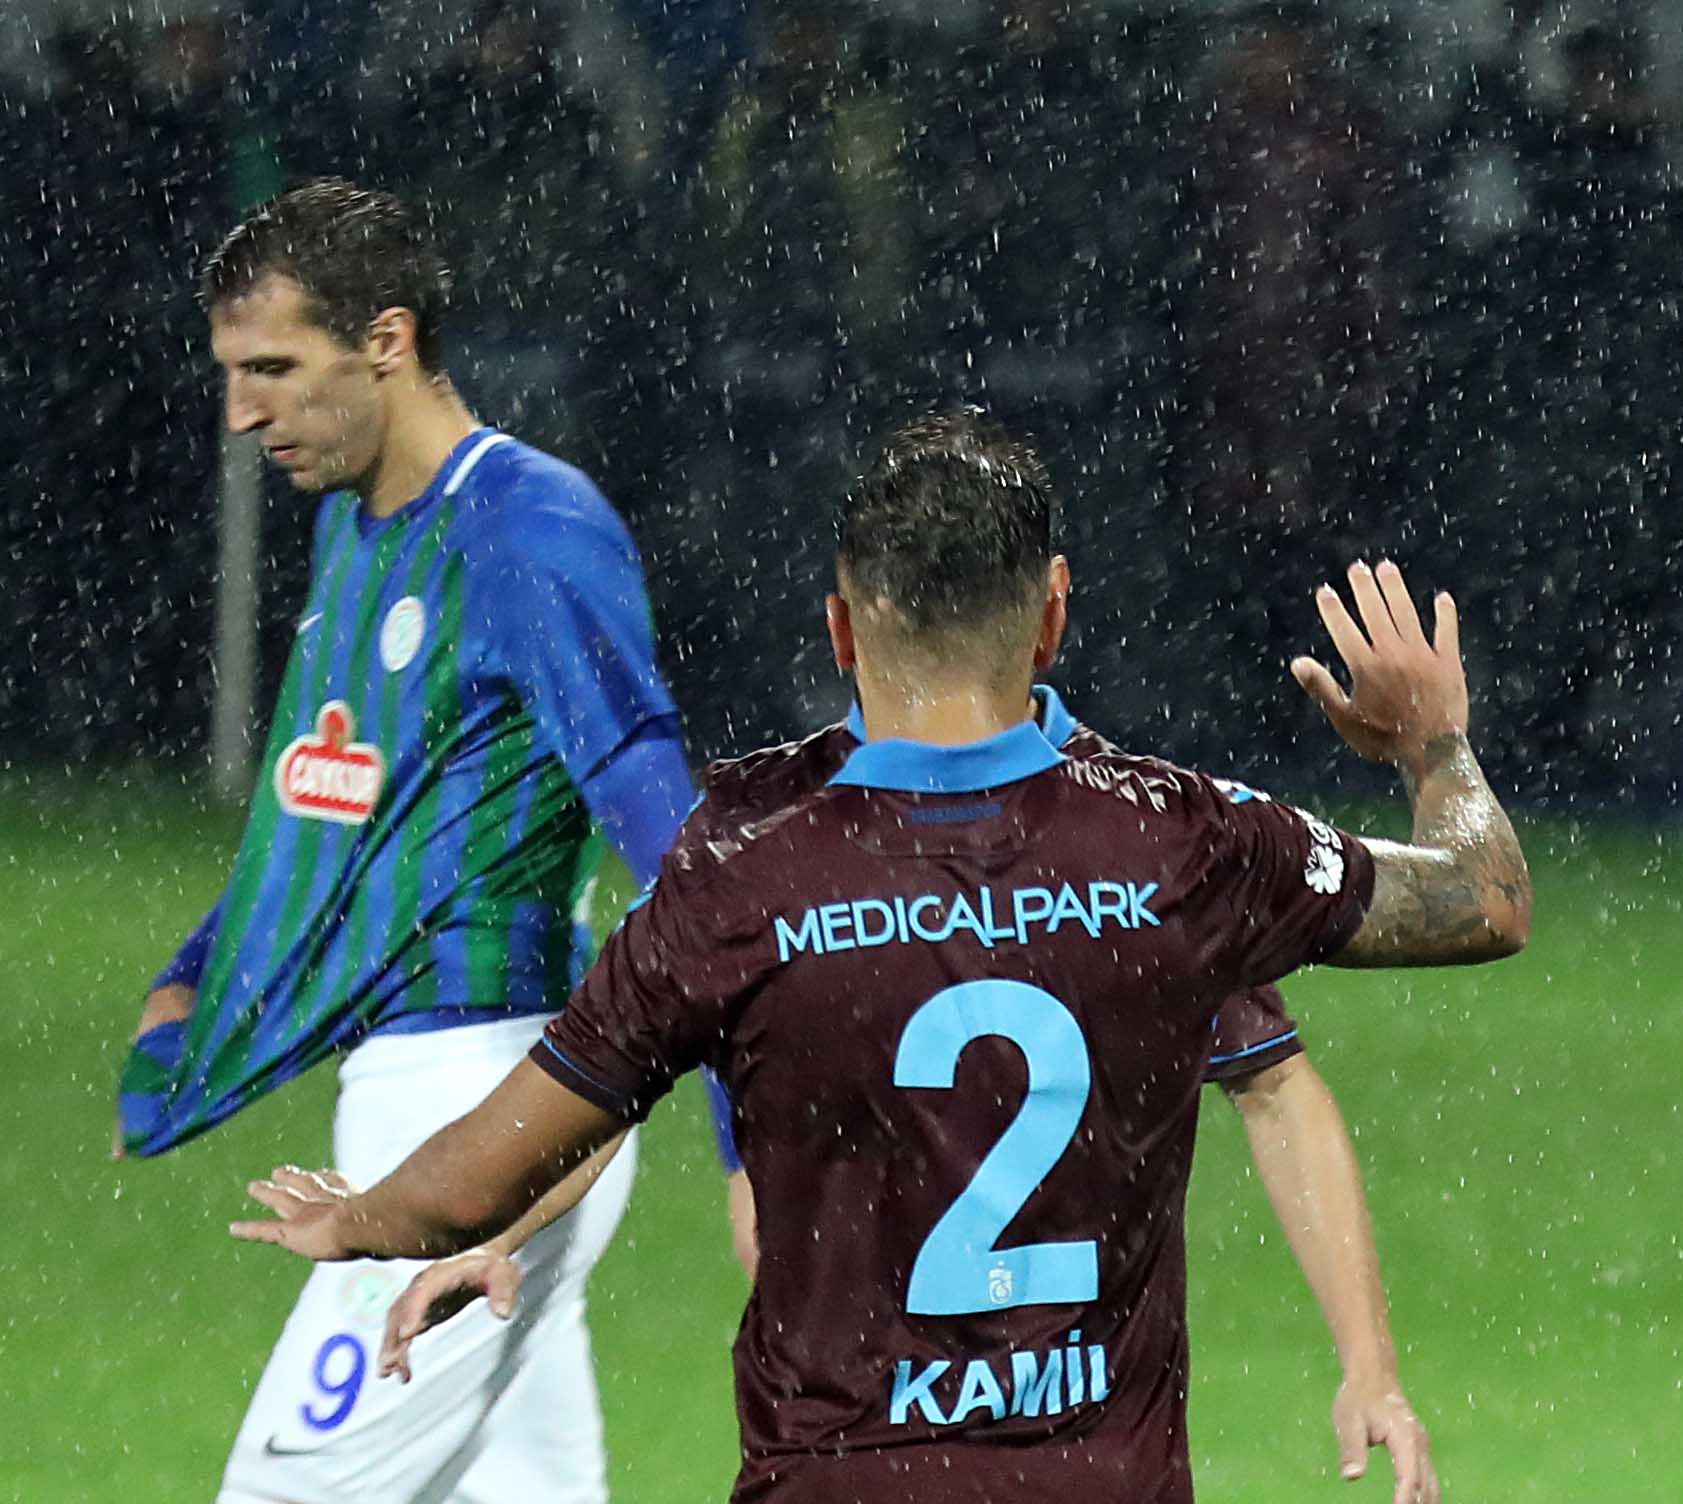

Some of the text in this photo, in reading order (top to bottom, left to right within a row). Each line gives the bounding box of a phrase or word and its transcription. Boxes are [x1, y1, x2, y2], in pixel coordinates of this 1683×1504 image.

[773, 881, 1161, 962] MEDICALPARK
[892, 978, 1099, 1316] 2
[300, 1332, 367, 1432] 9
